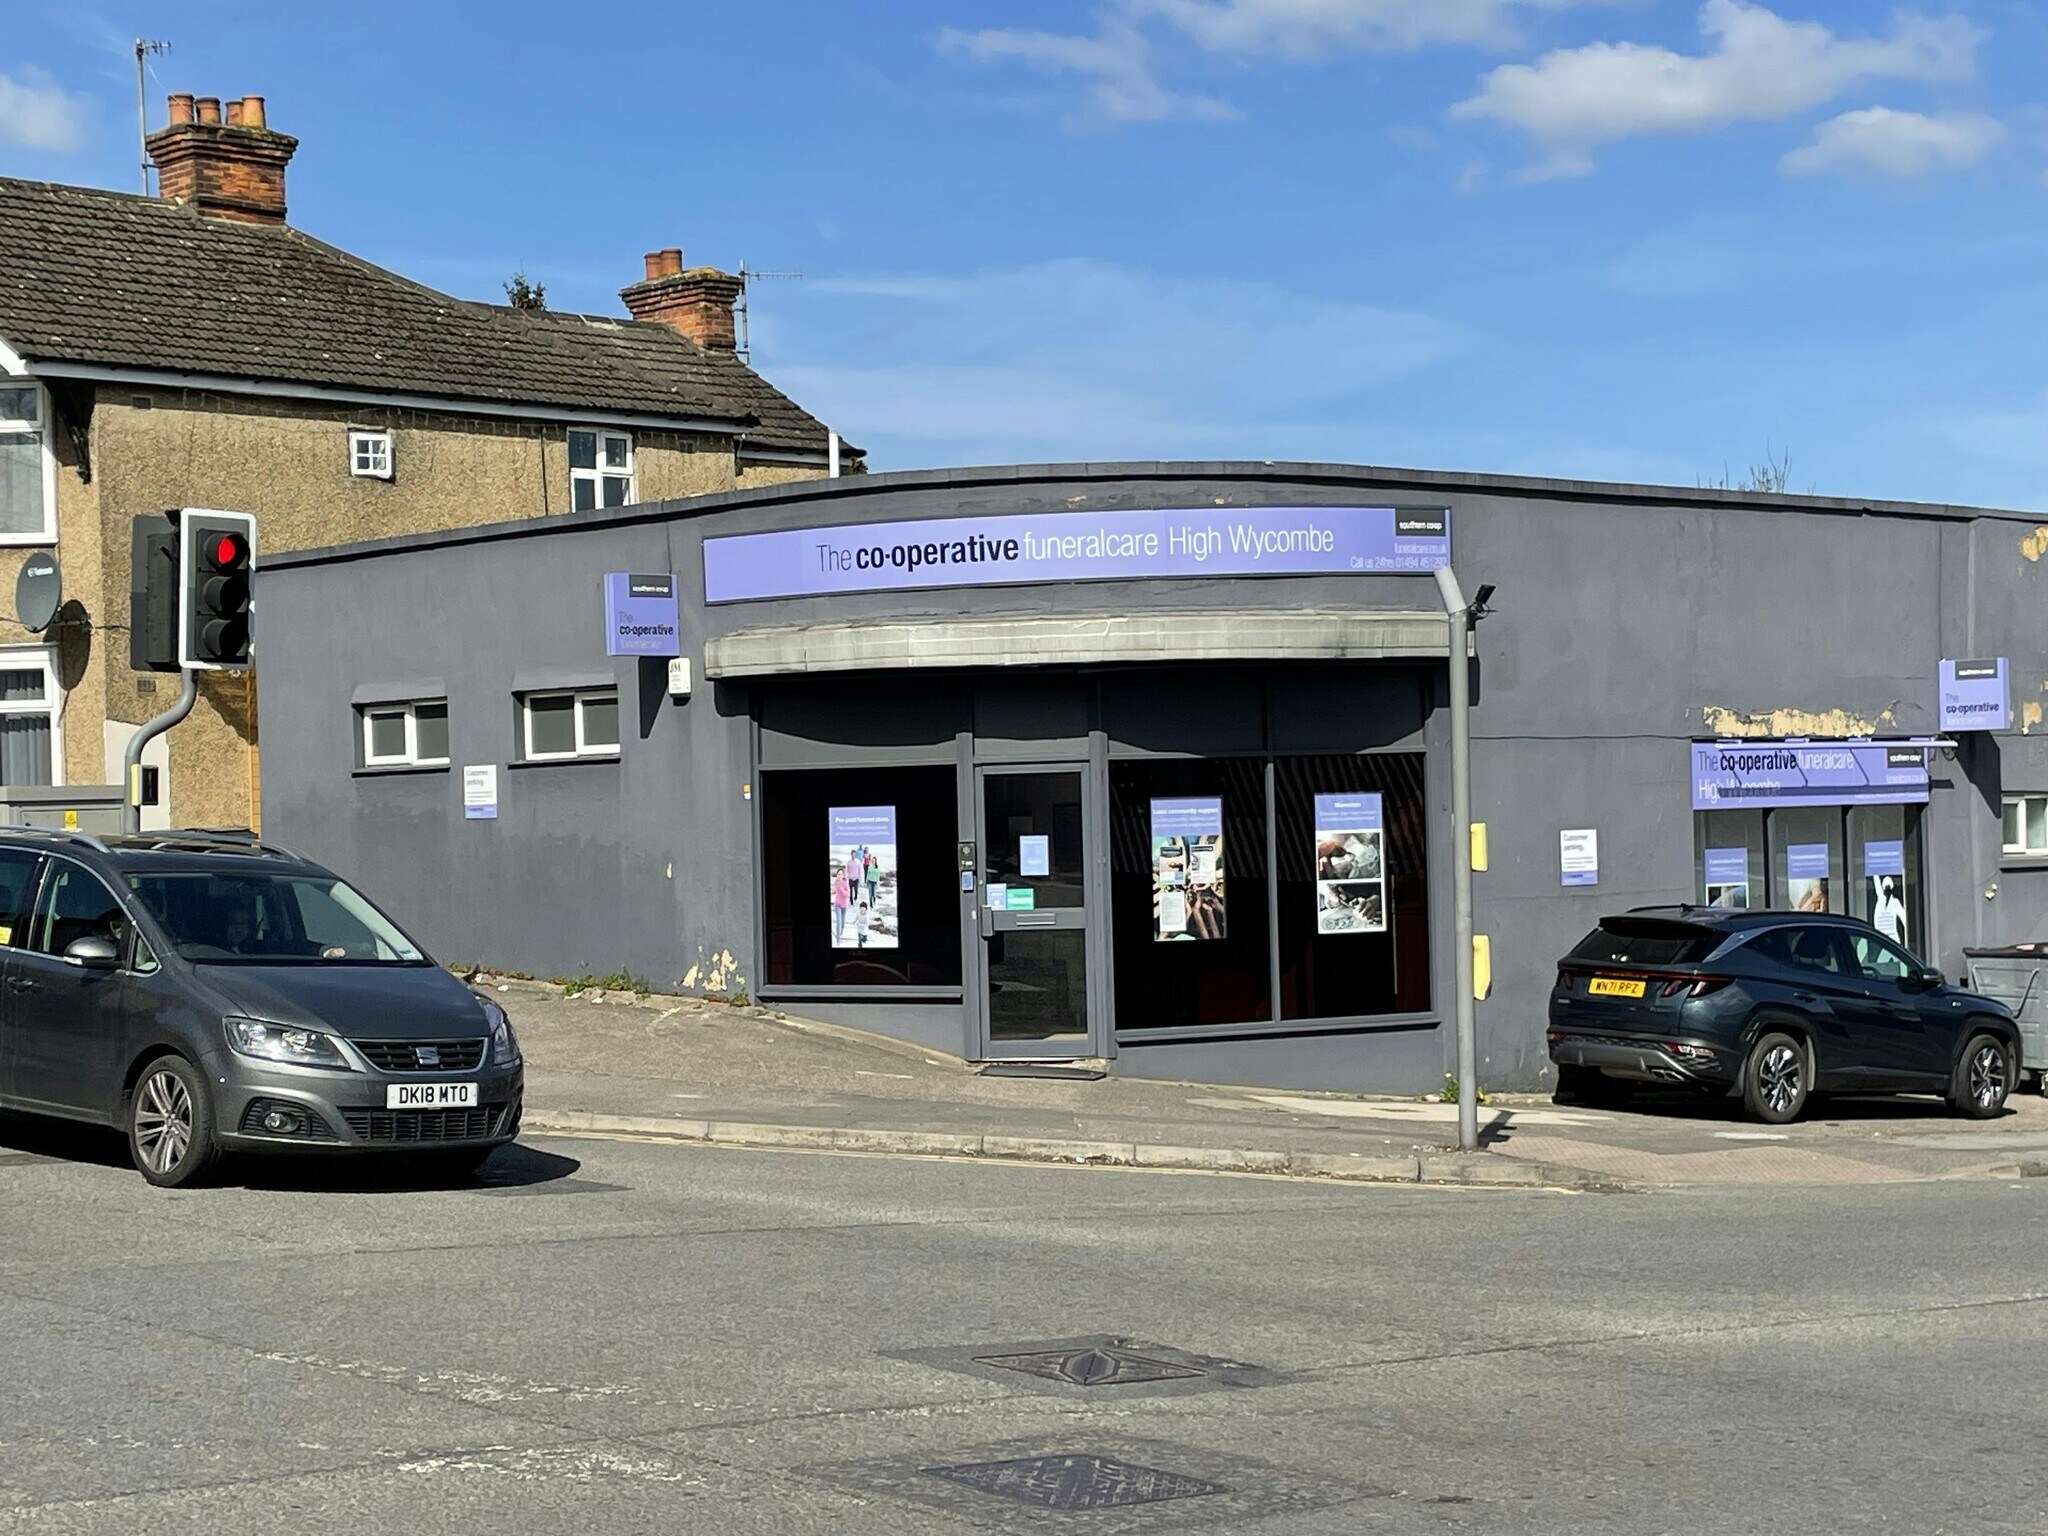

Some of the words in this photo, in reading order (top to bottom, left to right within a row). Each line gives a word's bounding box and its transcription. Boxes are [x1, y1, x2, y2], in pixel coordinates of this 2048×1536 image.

[816, 544, 851, 572] The
[1023, 528, 1159, 560] funeralcare
[1169, 525, 1222, 562] High
[1228, 523, 1334, 560] Wycombe
[1350, 556, 1364, 569] Call
[1698, 751, 1719, 772] The
[1798, 749, 1854, 770] funeralcare
[1698, 778, 1721, 805] High
[399, 1086, 435, 1104] DK18
[439, 1085, 468, 1103] MTO
